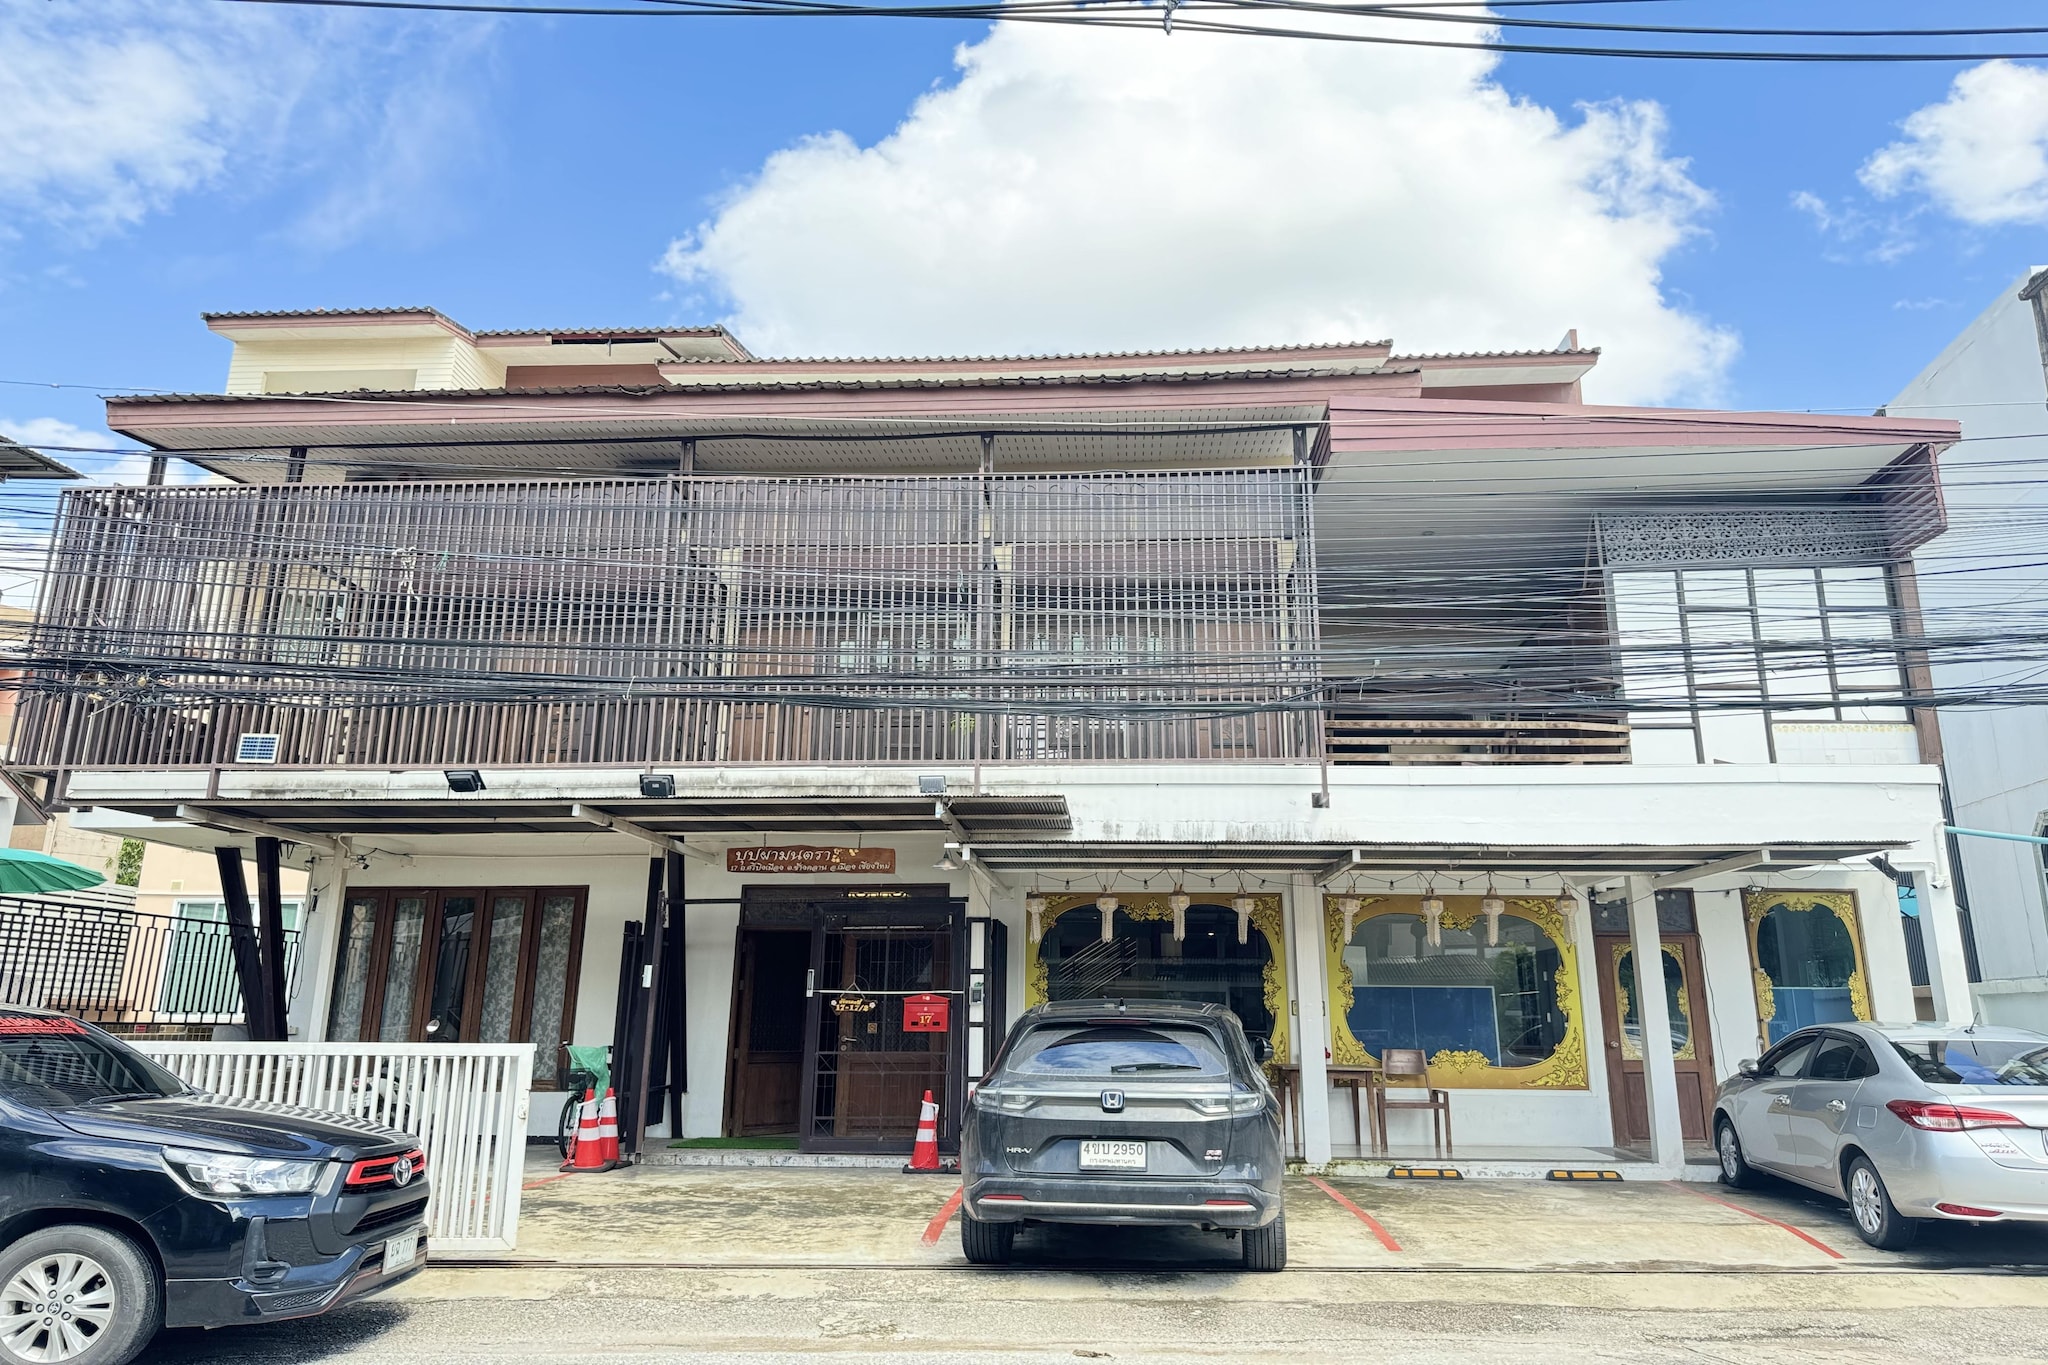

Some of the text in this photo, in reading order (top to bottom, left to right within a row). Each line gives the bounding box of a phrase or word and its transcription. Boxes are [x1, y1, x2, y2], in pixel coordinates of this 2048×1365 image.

[735, 848, 831, 865] บุปผามนตรา
[858, 861, 891, 870] เชียงใหม่
[919, 1015, 932, 1024] 17
[1006, 1146, 1033, 1154] HR-V
[1113, 1143, 1143, 1156] 2950
